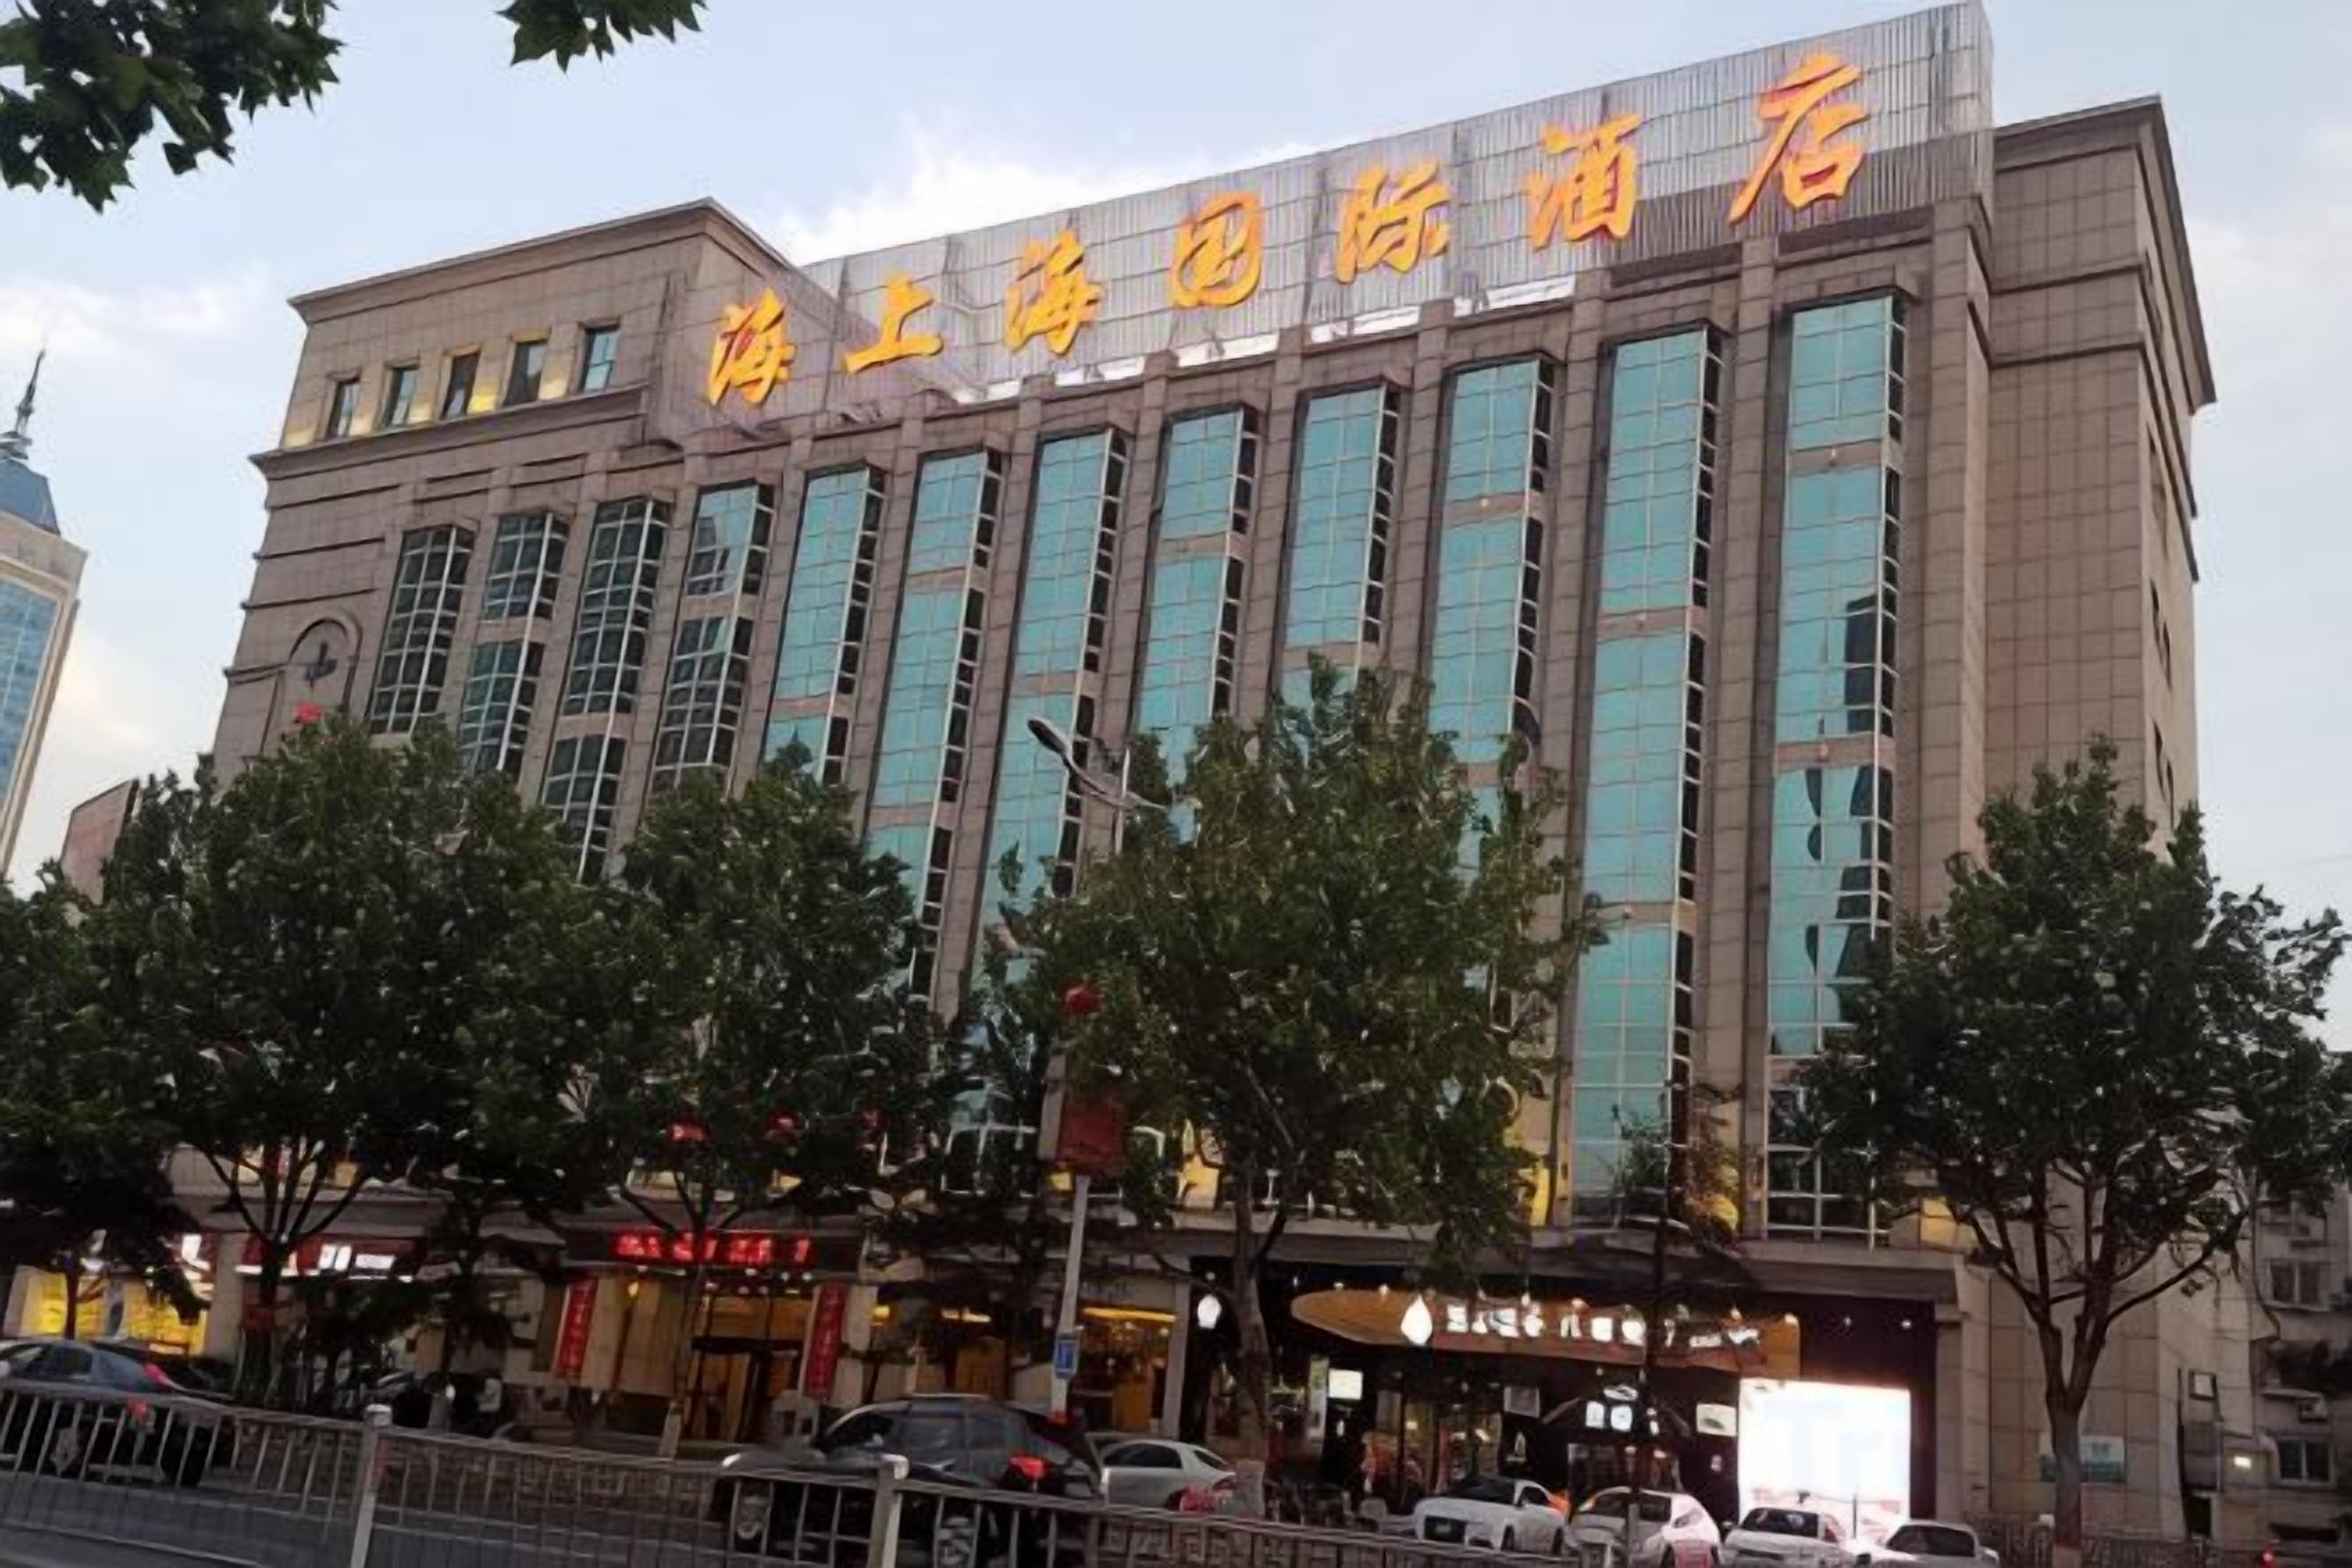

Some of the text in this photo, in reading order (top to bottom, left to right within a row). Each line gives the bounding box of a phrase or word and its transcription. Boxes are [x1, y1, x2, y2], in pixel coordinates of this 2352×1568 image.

[707, 53, 1870, 406] 海上海国际酒店
